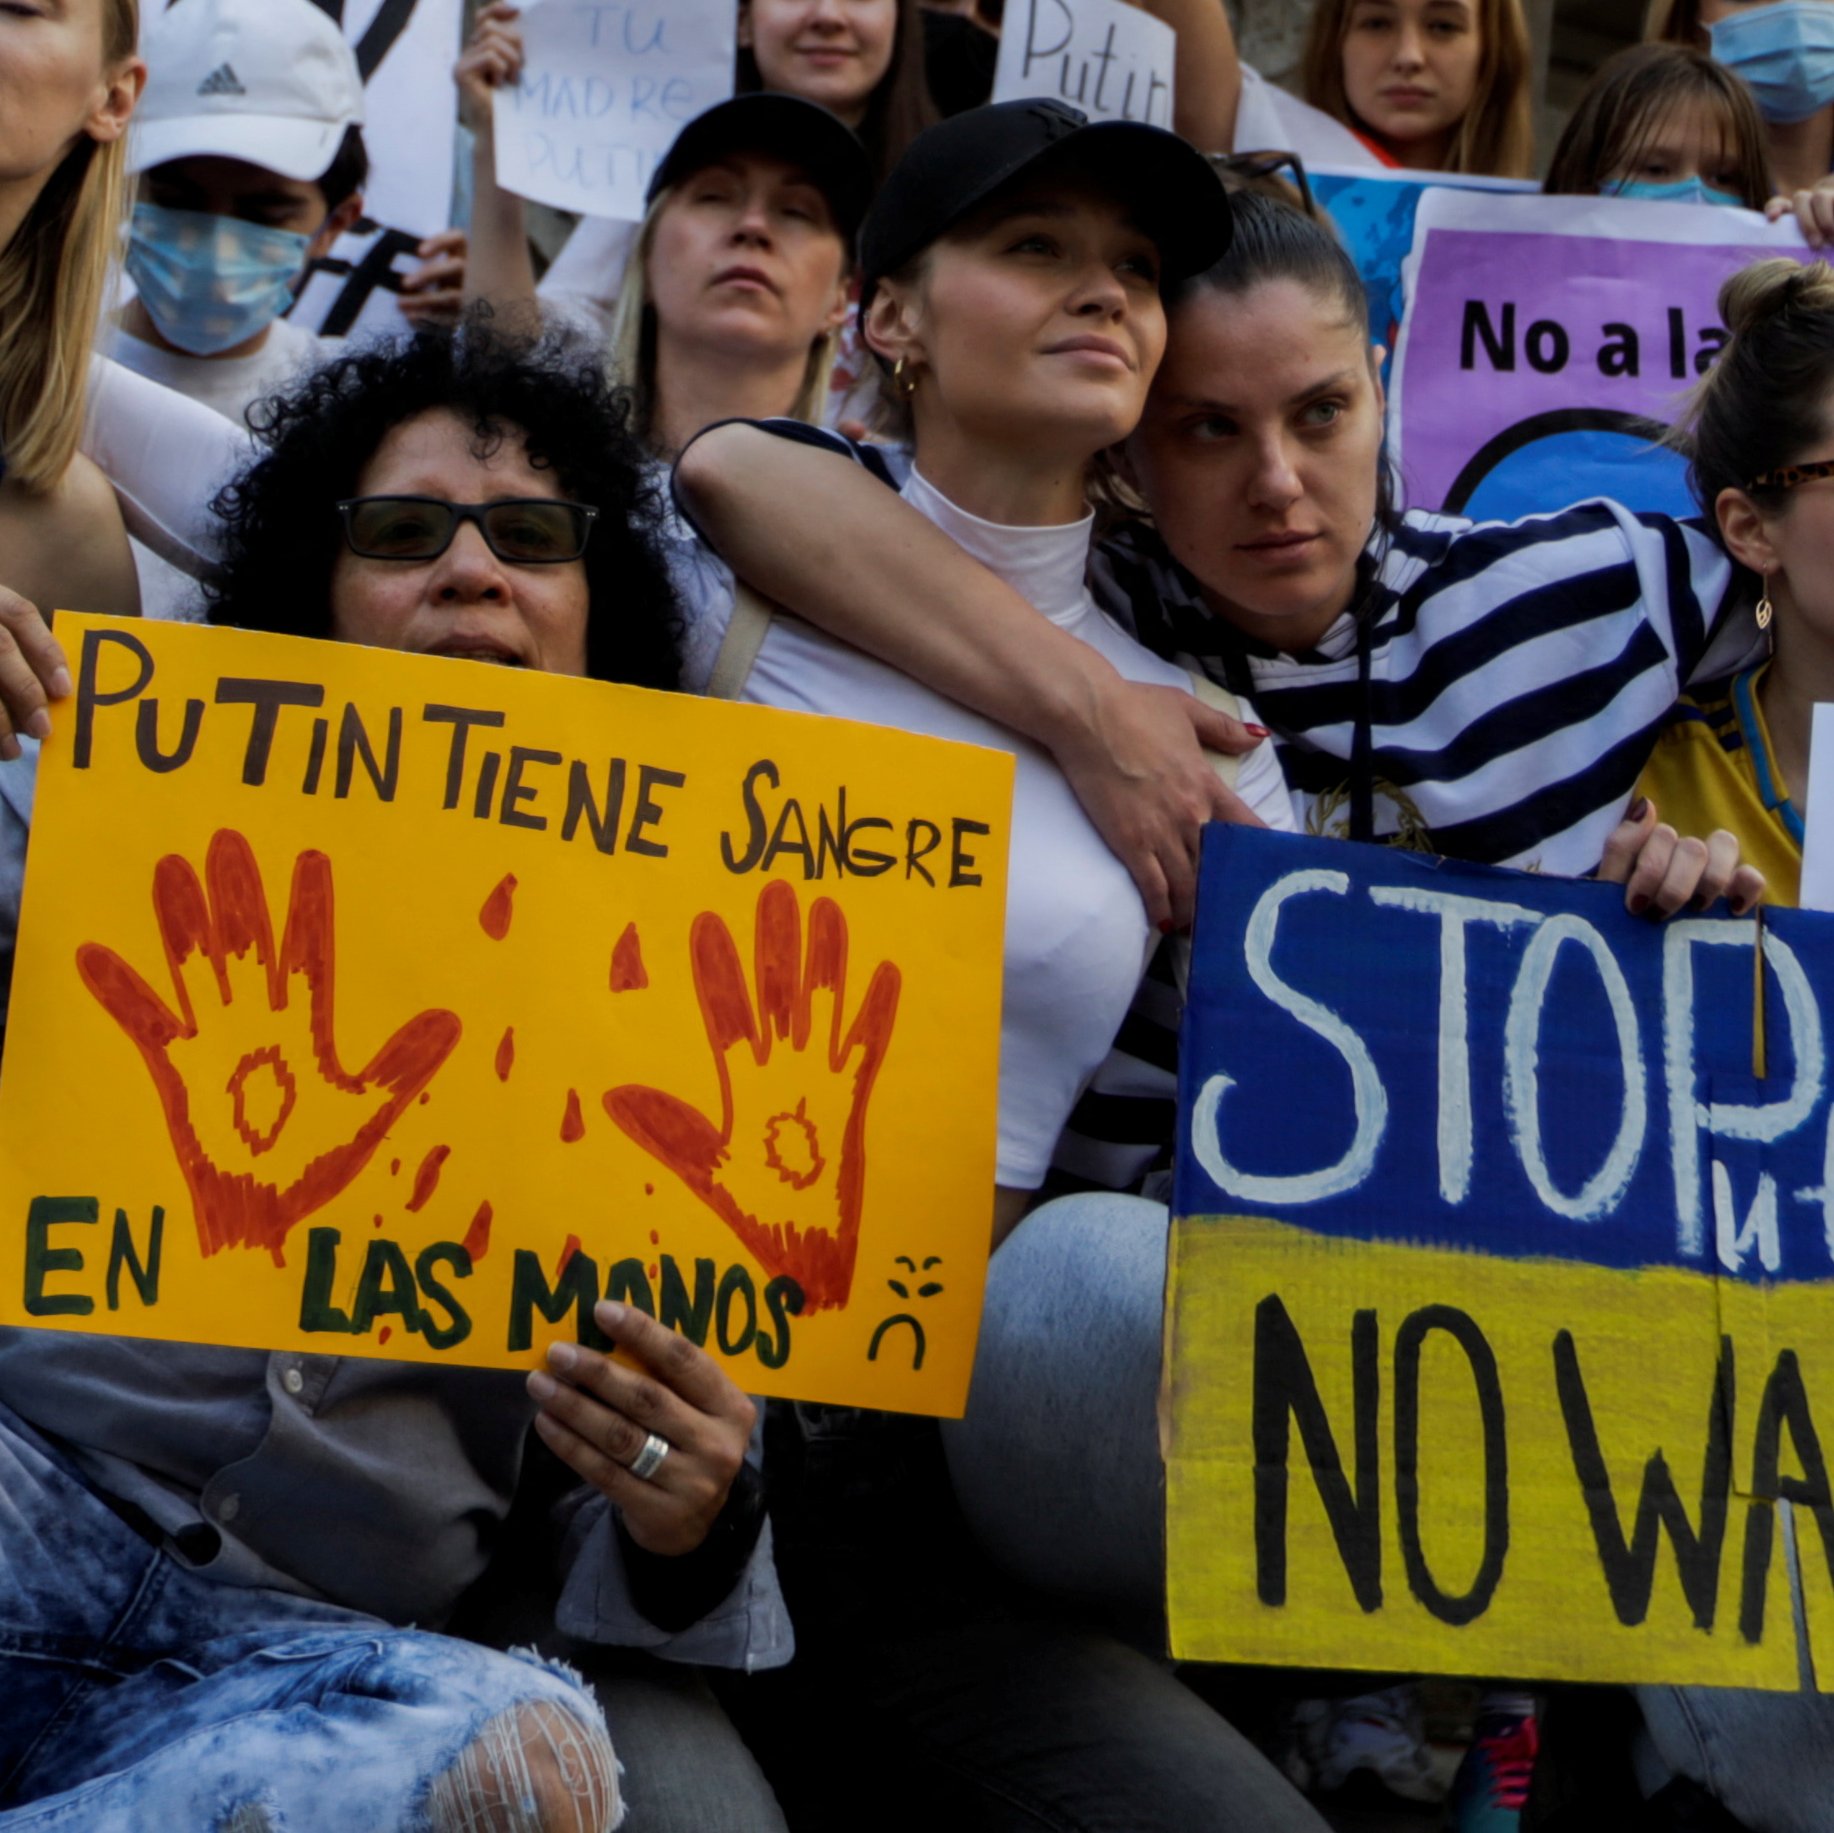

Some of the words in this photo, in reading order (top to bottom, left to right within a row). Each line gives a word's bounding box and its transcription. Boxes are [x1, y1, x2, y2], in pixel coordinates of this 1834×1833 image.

[524, 131, 661, 190] PUTI
[1459, 299, 1569, 374] No
[1596, 321, 1641, 378] a
[718, 757, 990, 890] SANGRE
[22, 1195, 166, 1315] EN
[298, 1224, 474, 1349] LAS
[508, 1247, 806, 1370] MANOS
[1252, 1291, 1509, 1626] NO
